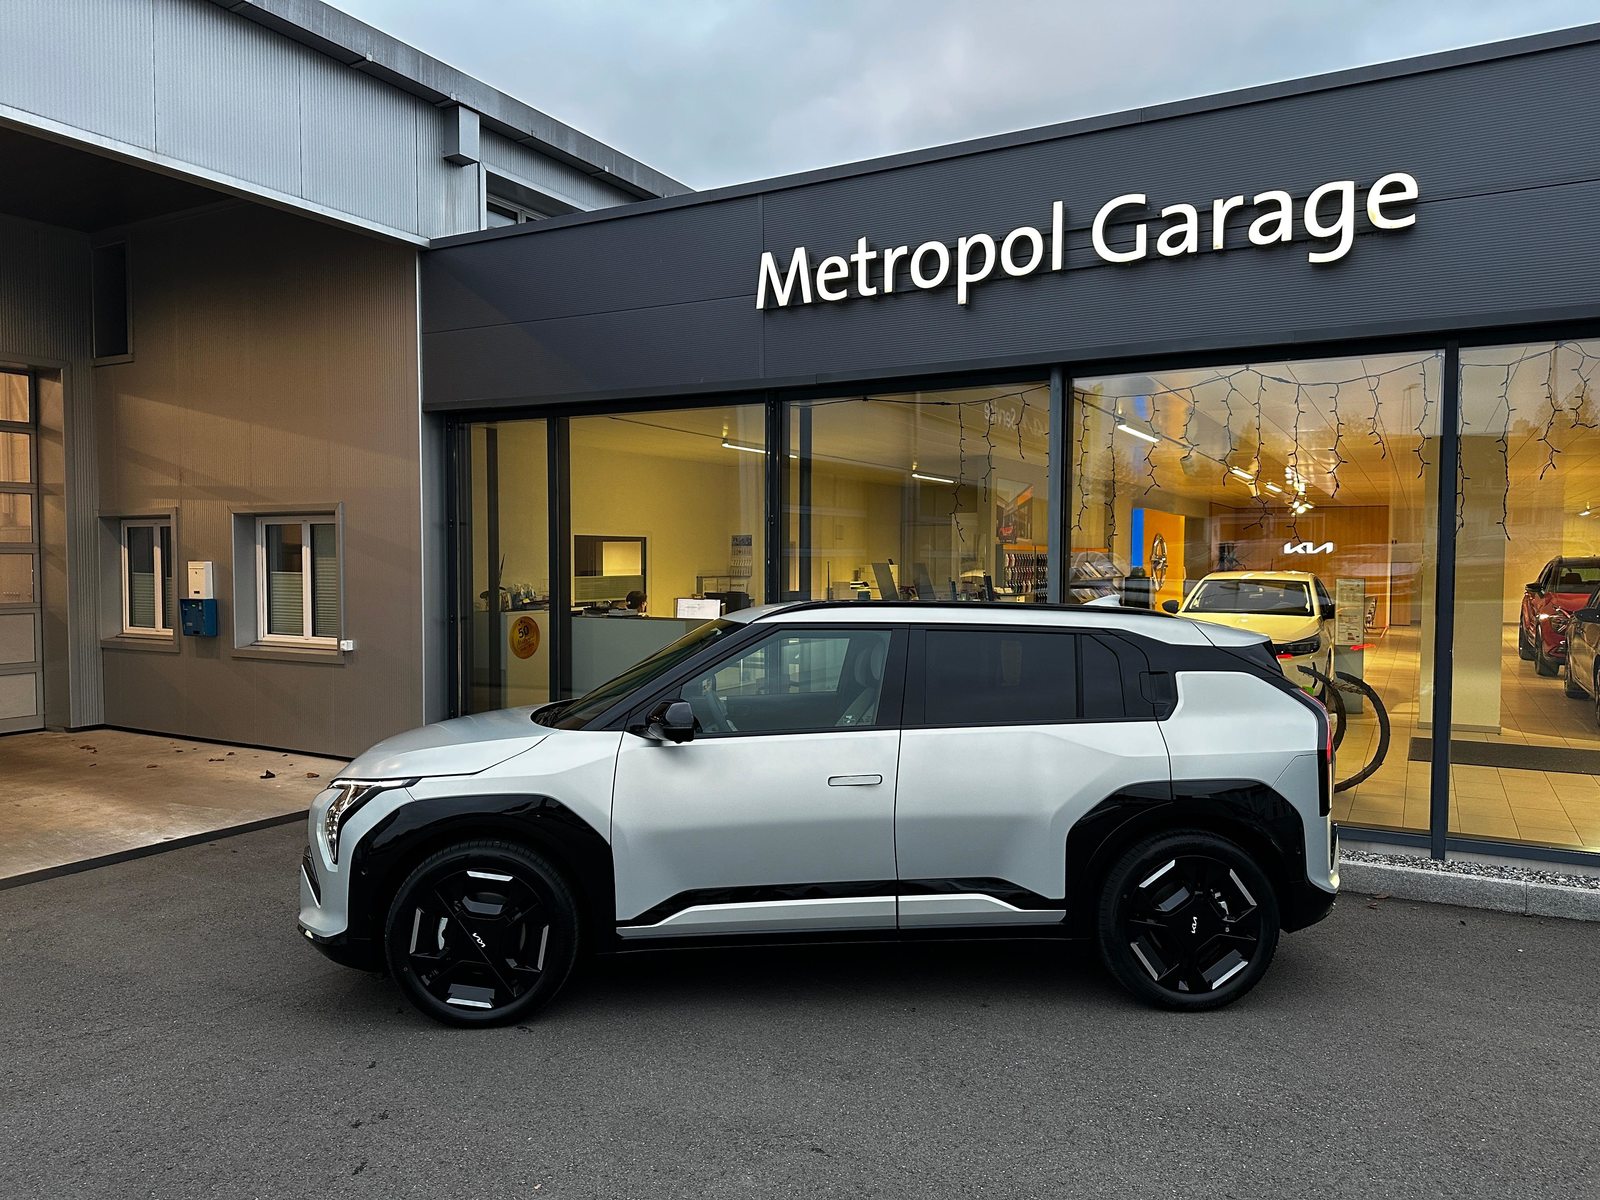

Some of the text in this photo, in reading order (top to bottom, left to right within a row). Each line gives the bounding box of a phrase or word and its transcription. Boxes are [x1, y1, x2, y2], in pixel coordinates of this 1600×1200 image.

[756, 172, 1419, 309] Metropol Garage
[1283, 541, 1334, 554] KIA
[518, 625, 529, 638] 50
